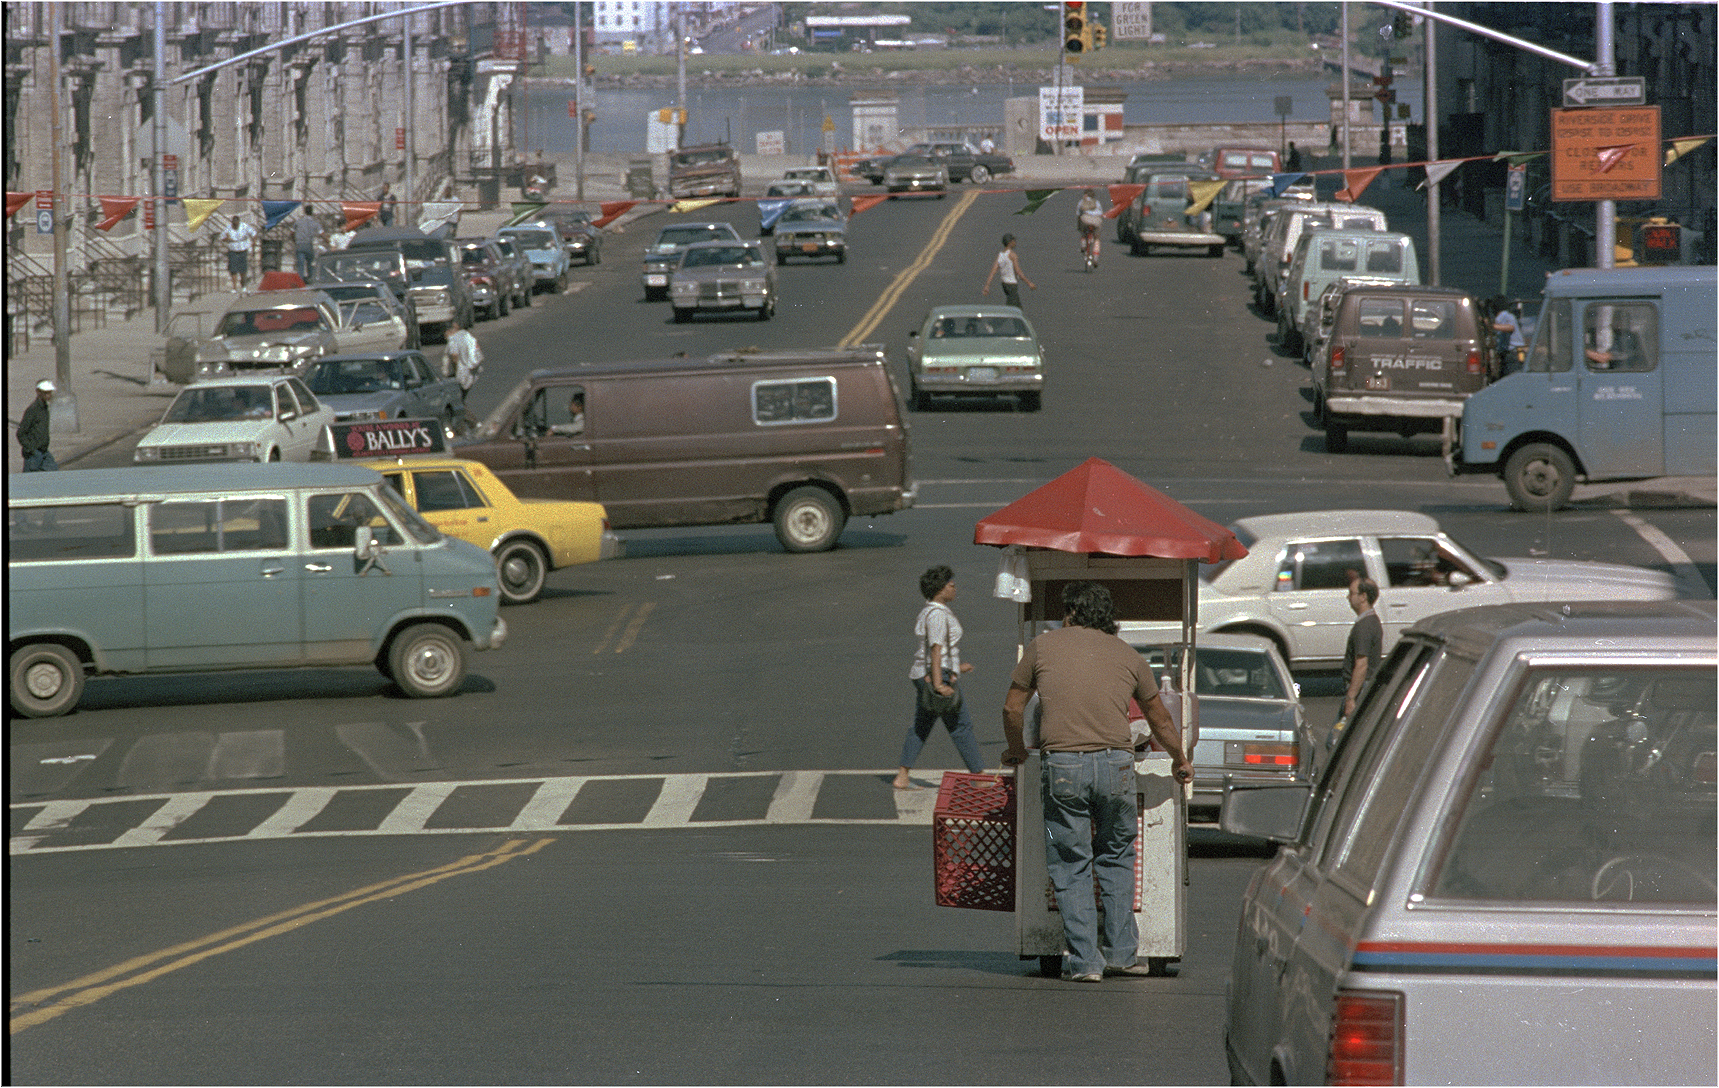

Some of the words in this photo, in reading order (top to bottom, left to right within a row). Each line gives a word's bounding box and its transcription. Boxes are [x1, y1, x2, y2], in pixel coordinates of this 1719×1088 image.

[1116, 13, 1148, 25] GREEN
[1118, 25, 1146, 36] LIGHT
[1574, 86, 1598, 97] ONE
[1613, 86, 1637, 96] WAY
[1045, 125, 1079, 135] OPEN
[1561, 183, 1582, 194] USE
[1370, 357, 1442, 370] TRAFFIC
[365, 427, 433, 451] BALLY'S
